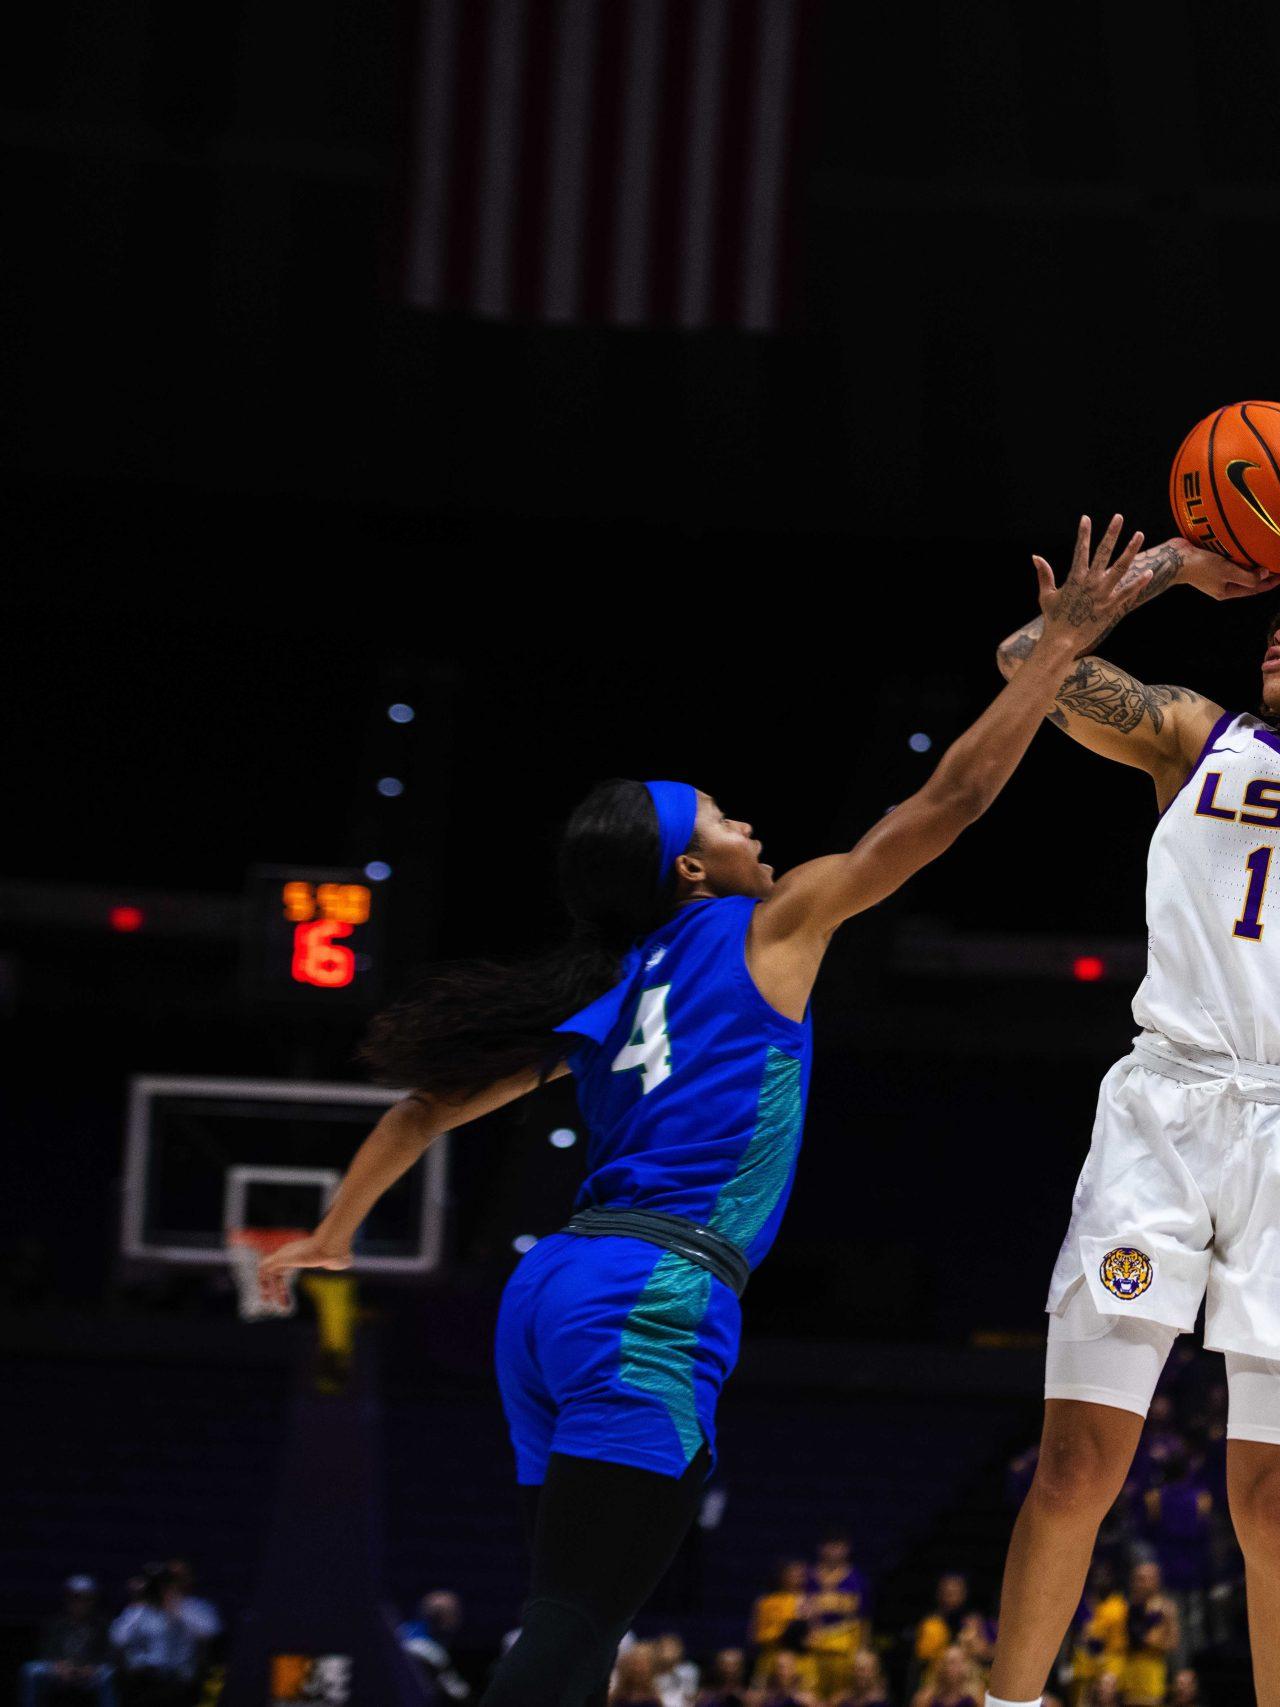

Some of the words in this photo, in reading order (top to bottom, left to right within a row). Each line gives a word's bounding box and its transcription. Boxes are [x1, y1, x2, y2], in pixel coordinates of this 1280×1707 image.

[1233, 846, 1273, 942] 1
[291, 920, 355, 988] 6
[611, 982, 672, 1096] 4
